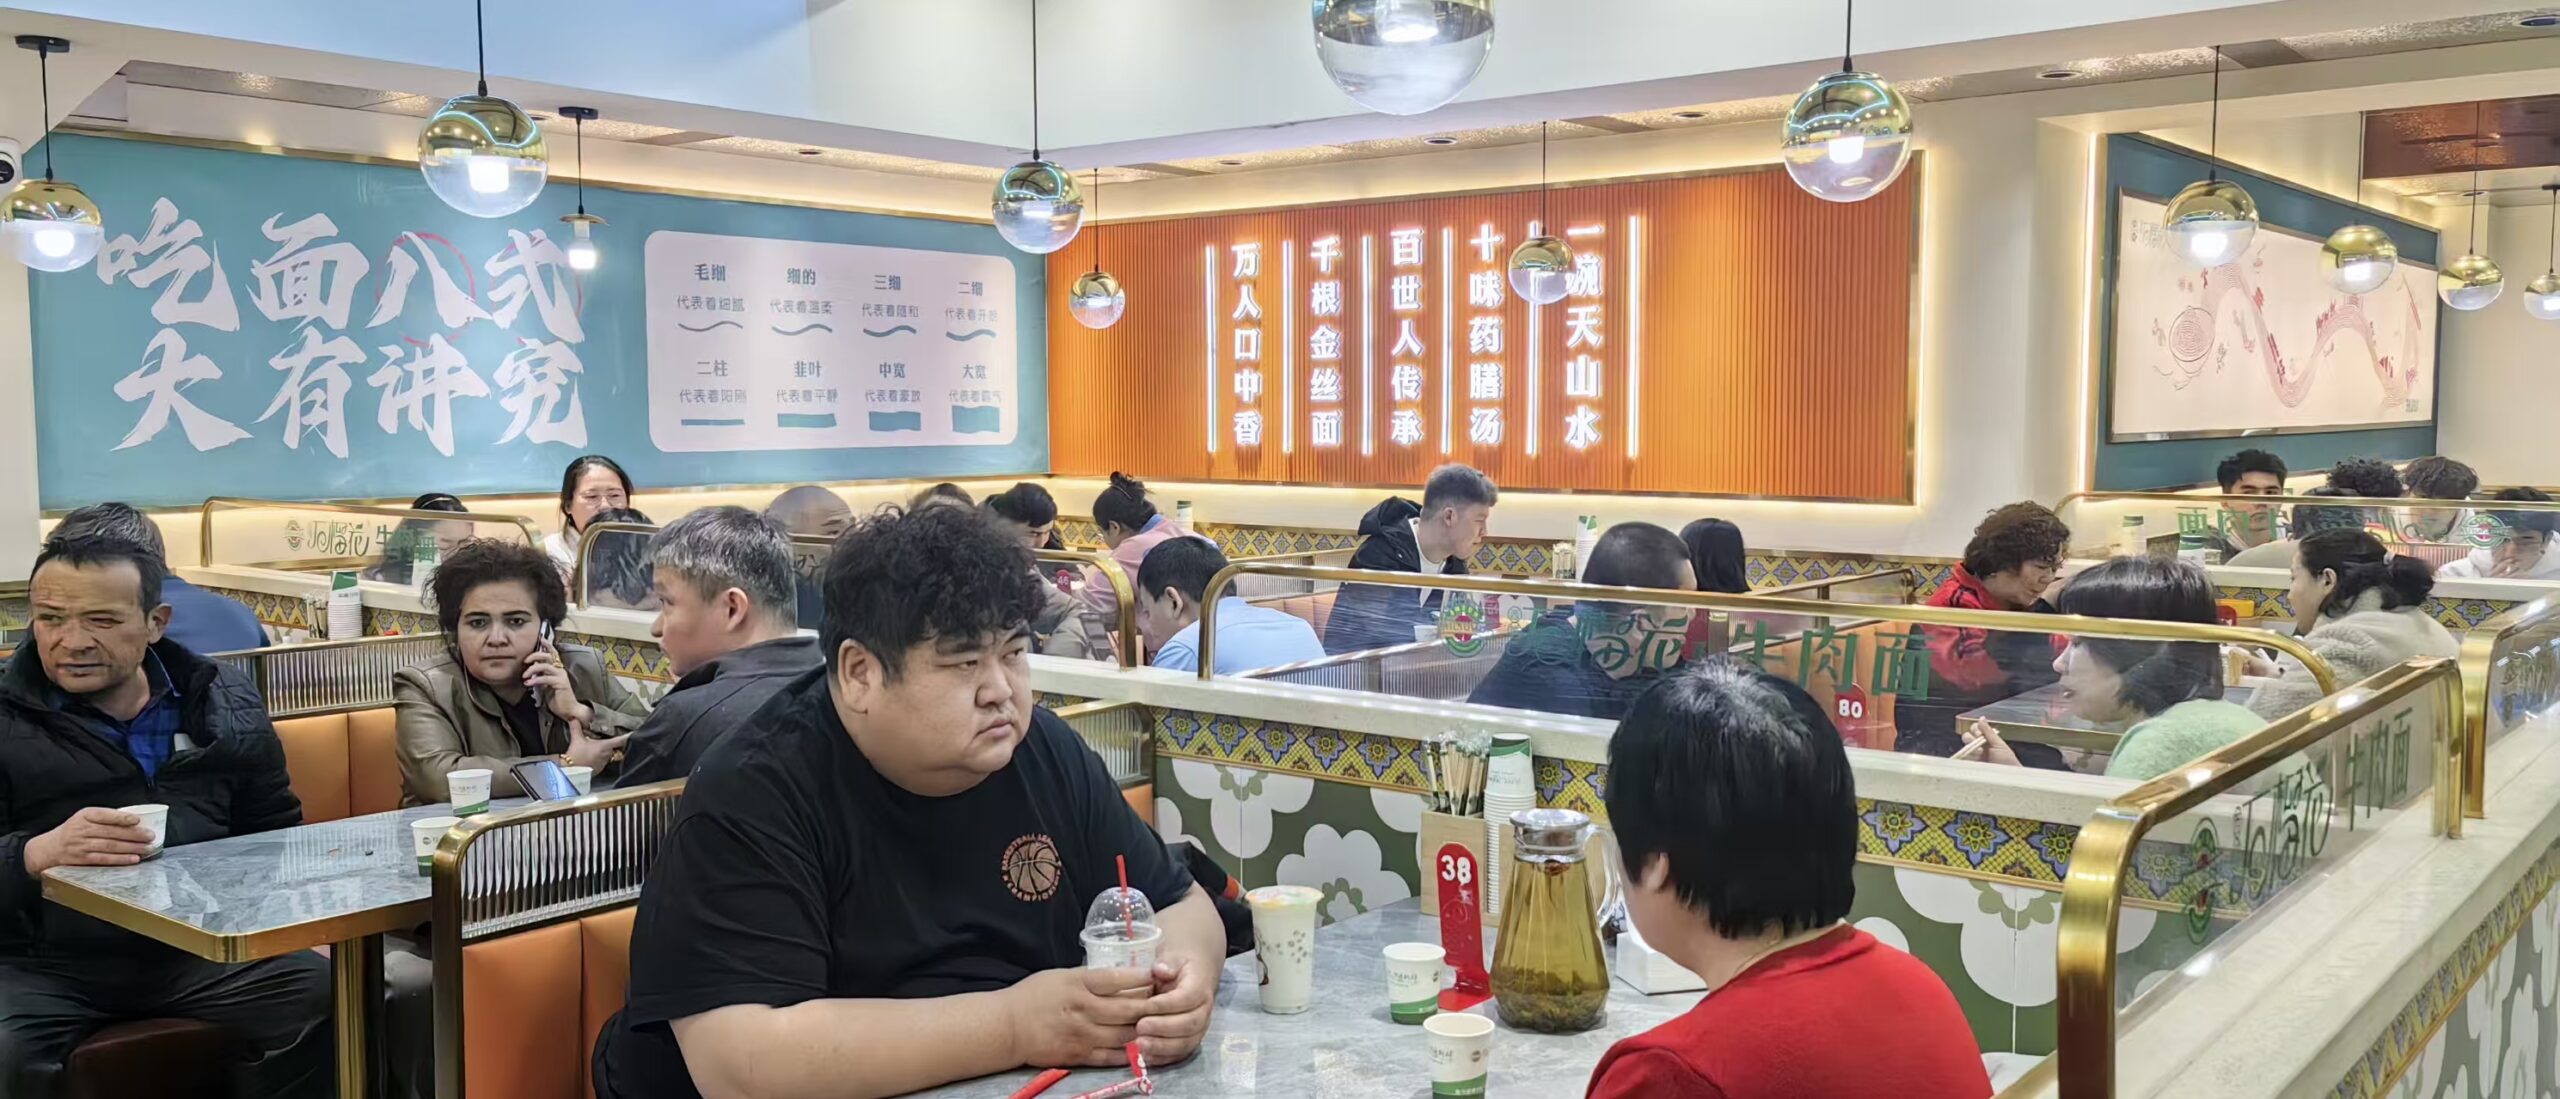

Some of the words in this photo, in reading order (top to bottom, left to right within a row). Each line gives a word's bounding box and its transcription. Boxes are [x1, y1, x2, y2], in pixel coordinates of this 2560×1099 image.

[96, 196, 587, 343] 吃面八式
[695, 263, 726, 281] 毛细
[787, 268, 816, 285] 细的
[874, 274, 902, 291] 三细
[958, 281, 984, 296] 二细
[1231, 243, 1262, 446] 万人口中香
[1310, 234, 1341, 446] 千根金丝面
[1391, 228, 1424, 446] 百世人传承
[1469, 223, 1502, 447] 十味药膳汤
[697, 360, 728, 377] 二柱
[794, 360, 822, 378] 韭叶
[880, 362, 906, 379] 中宽
[962, 364, 987, 380] 大宽
[110, 327, 588, 458] 大有讲究
[1732, 619, 1936, 701] 牛肉面
[1838, 699, 1864, 719] 80
[2345, 707, 2413, 832] 牛肉面
[1441, 855, 1472, 885] 38
